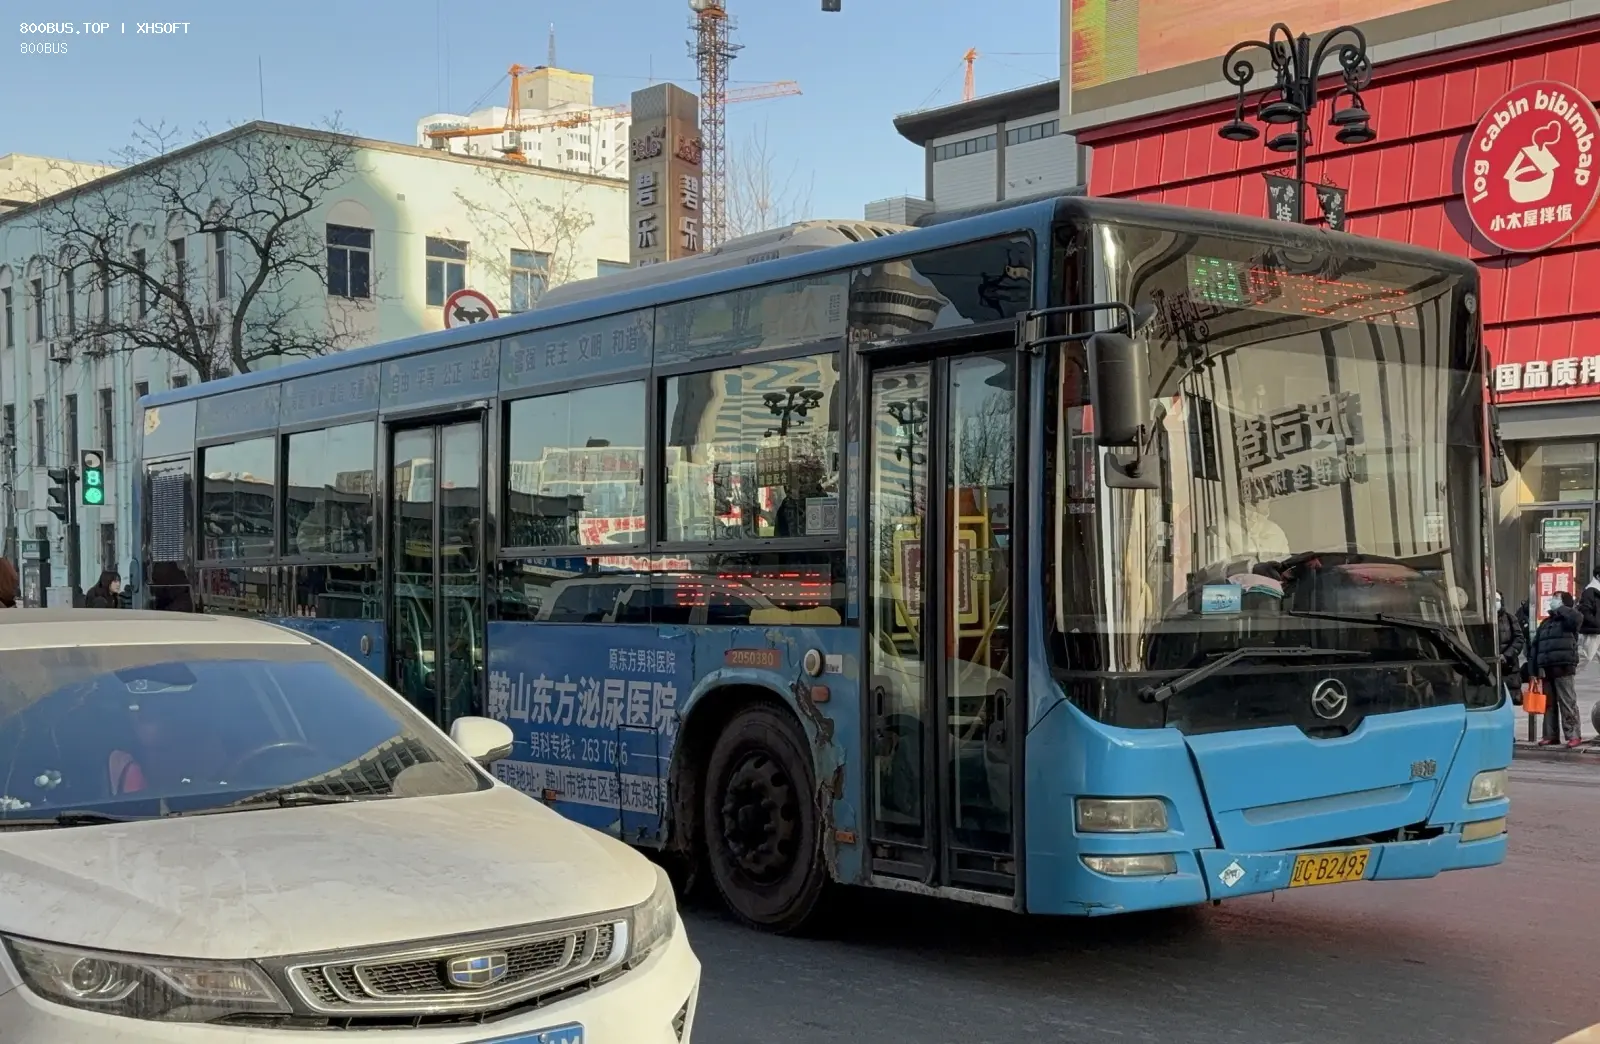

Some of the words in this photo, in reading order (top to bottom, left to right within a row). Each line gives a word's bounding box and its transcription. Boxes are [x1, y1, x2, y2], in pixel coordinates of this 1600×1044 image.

[1480, 97, 1530, 152] cabin
[1534, 89, 1595, 187] bibimbap
[1472, 159, 1490, 204] log
[1489, 203, 1573, 232] 小木屋拌饭
[545, 340, 569, 368] 民主
[577, 332, 604, 361] 文明
[611, 324, 639, 355] 和谐
[1491, 354, 1600, 391] 国品质拌
[608, 648, 676, 674] 原东方男科医院
[731, 651, 774, 666] 2050380
[488, 670, 678, 737] 鞍山东方泌尿医院
